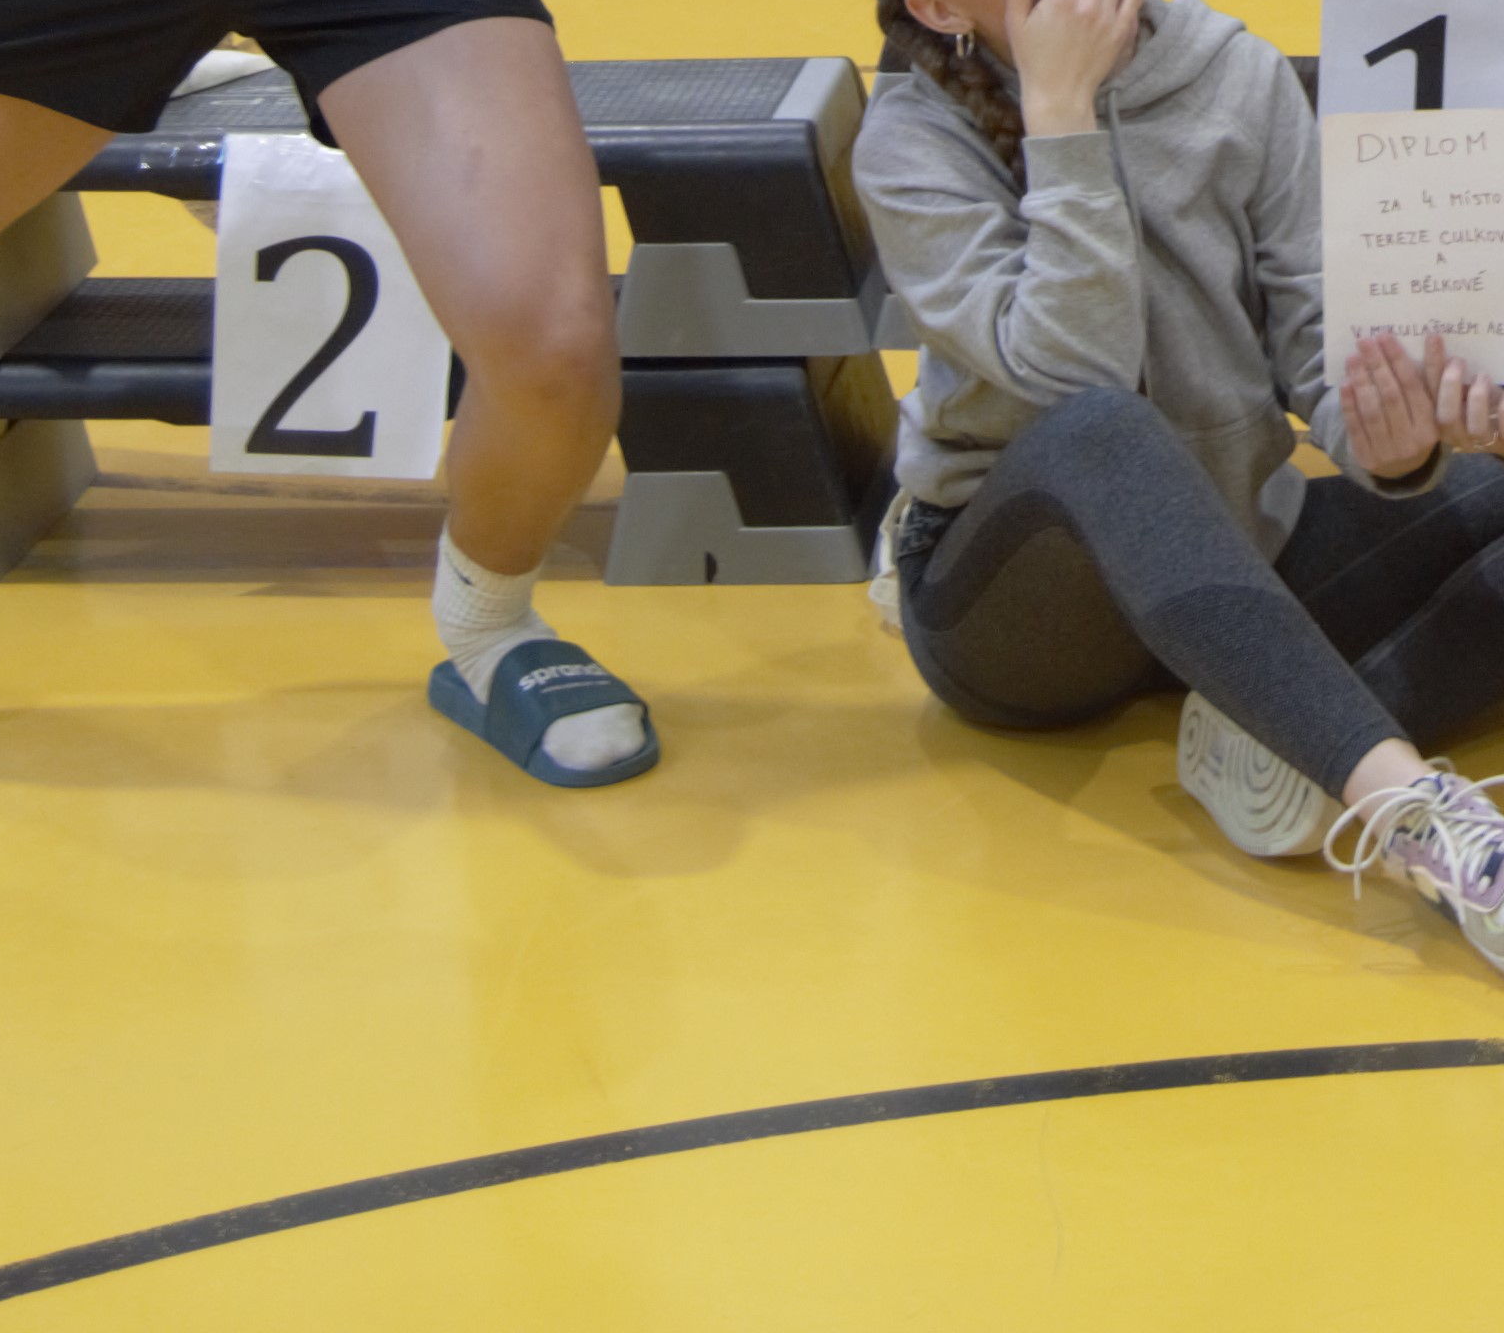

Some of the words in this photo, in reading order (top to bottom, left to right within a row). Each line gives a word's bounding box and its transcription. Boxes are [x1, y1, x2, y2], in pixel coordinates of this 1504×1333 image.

[1357, 131, 1487, 163] DIPLOM
[1378, 198, 1401, 214] ZA
[1359, 228, 1431, 249] TEREZE
[1435, 251, 1448, 265] A
[1368, 282, 1400, 297] ELE
[246, 235, 380, 458] 2
